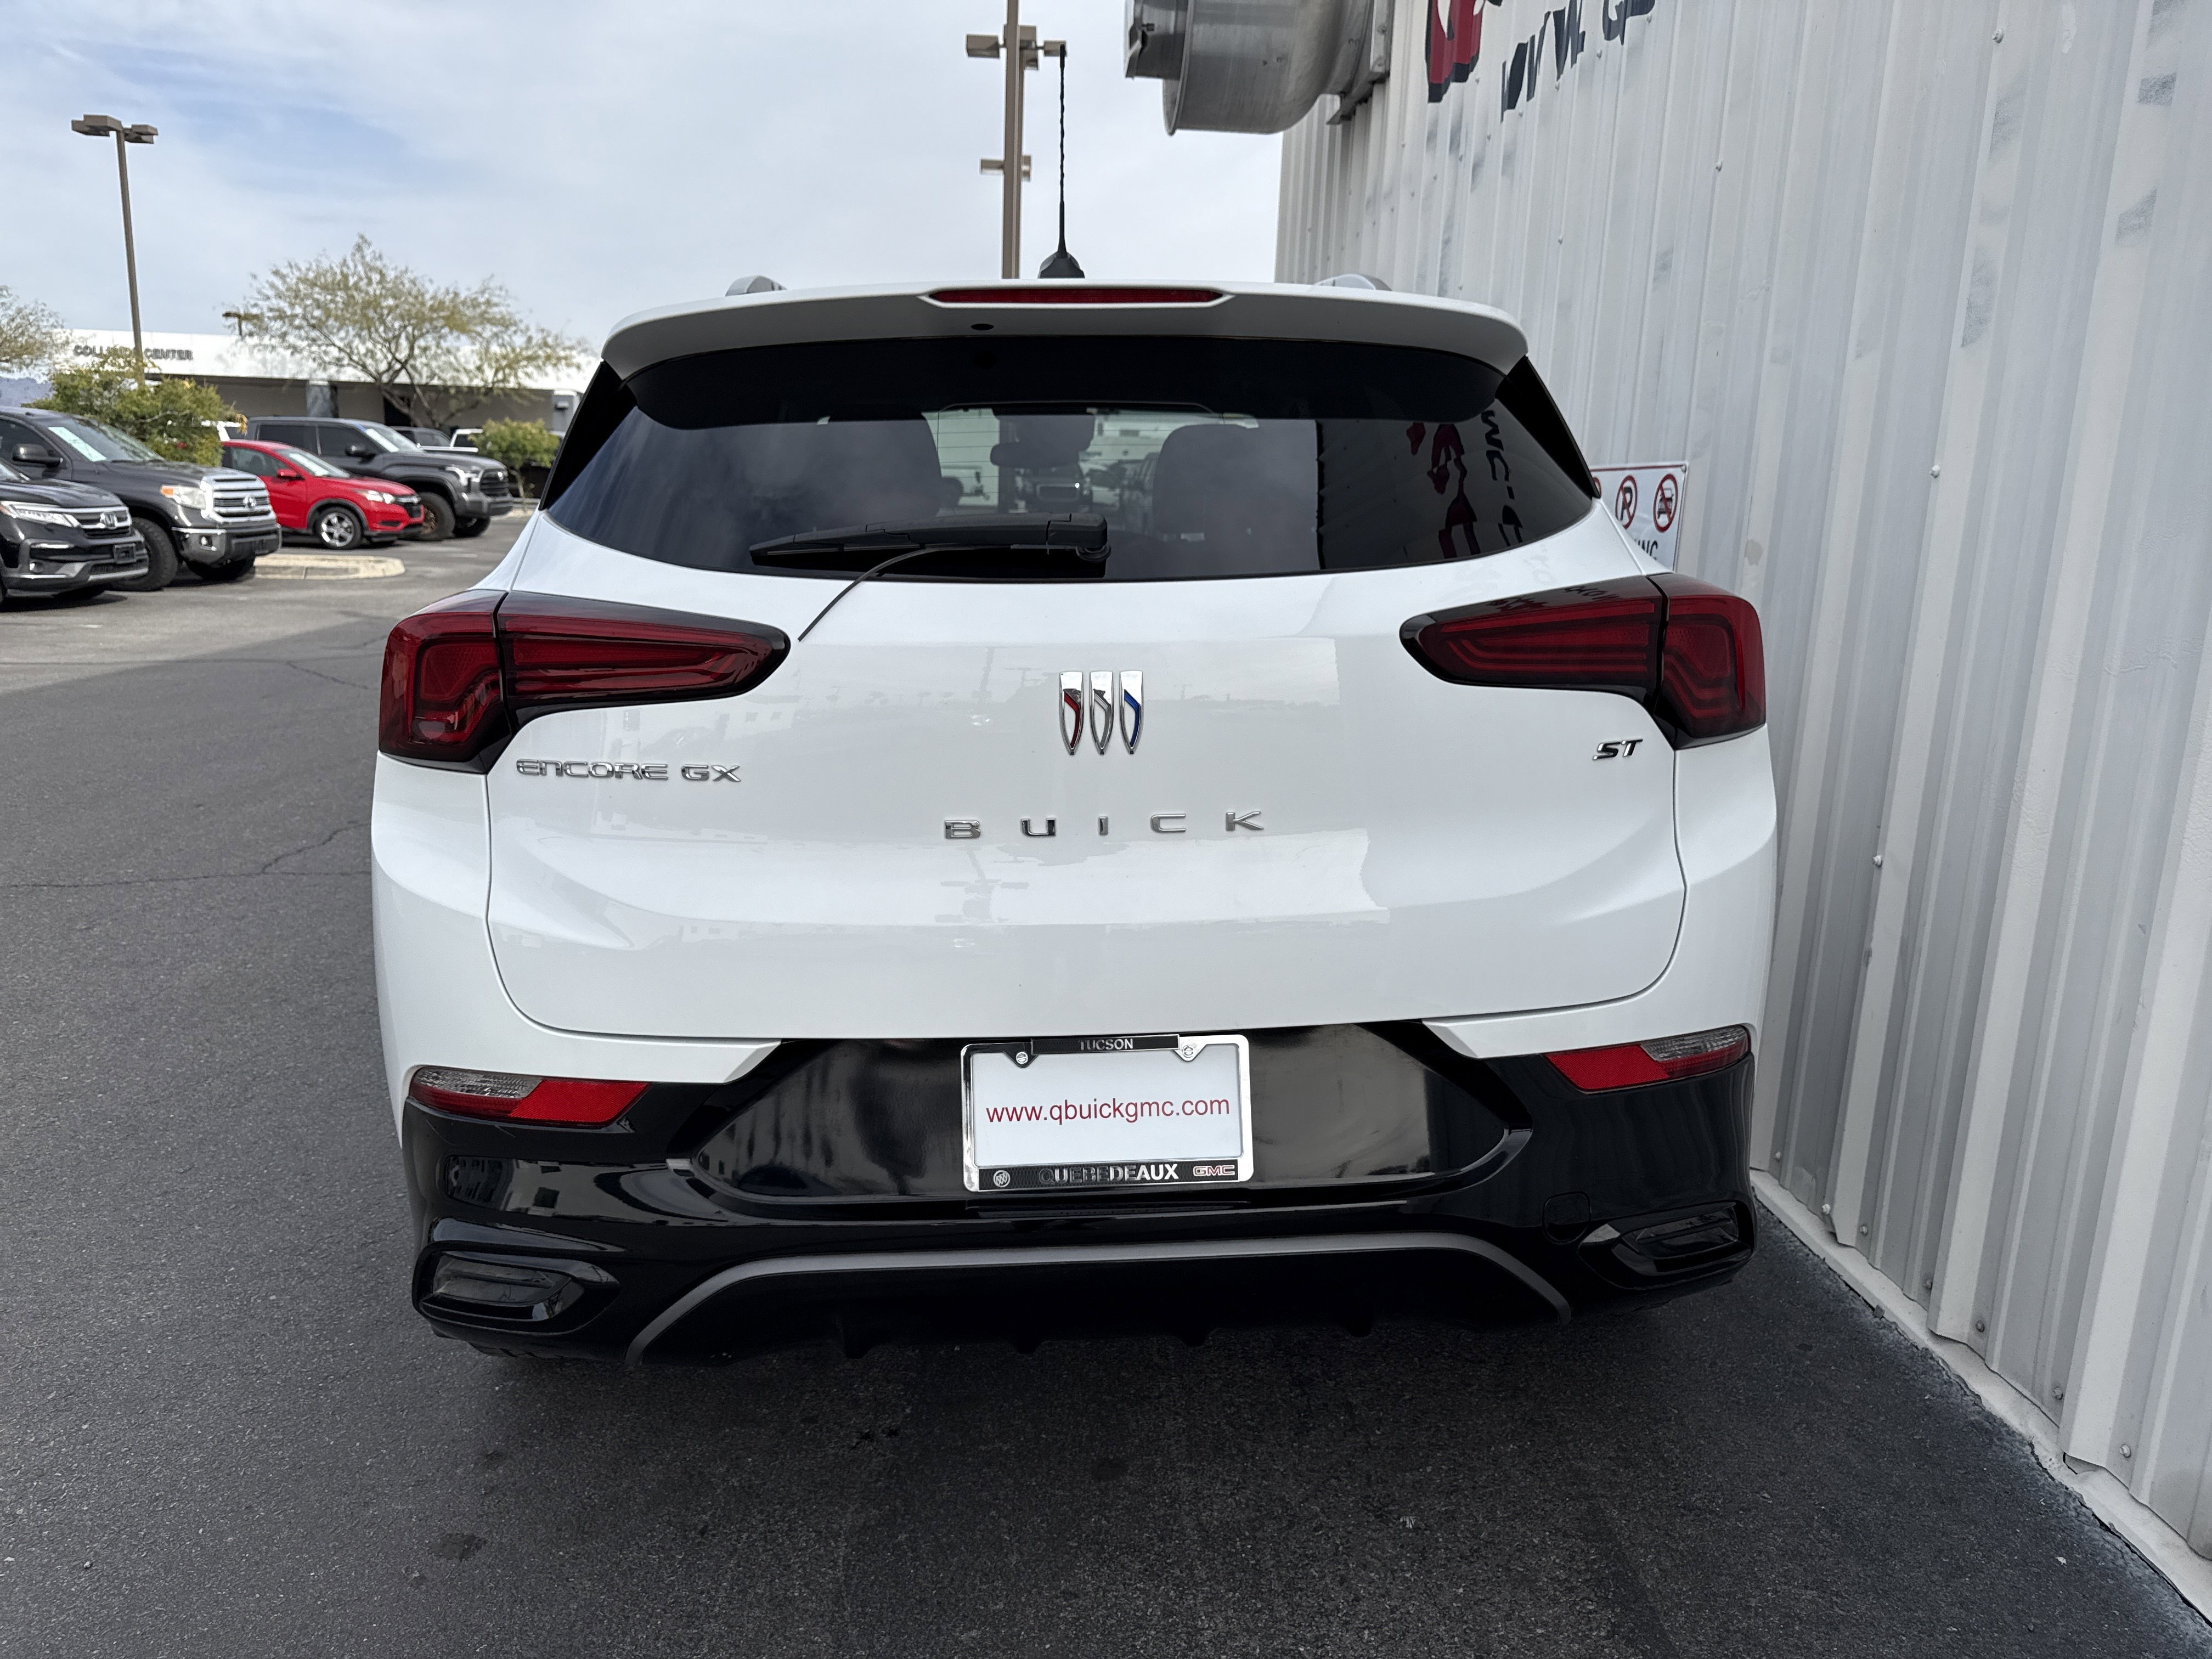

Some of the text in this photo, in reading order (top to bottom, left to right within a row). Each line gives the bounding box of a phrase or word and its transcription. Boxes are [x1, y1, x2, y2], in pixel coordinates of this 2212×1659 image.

[144, 348, 193, 360] CENTER
[1593, 738, 1643, 761] ST
[516, 759, 741, 782] ENCORE GX
[944, 811, 1264, 839] BUICK
[1079, 1039, 1133, 1051] TUCSON
[986, 1098, 1229, 1125] www.qbuickgmc.com
[1038, 1164, 1235, 1184] QUEBEDEAUX GMC
